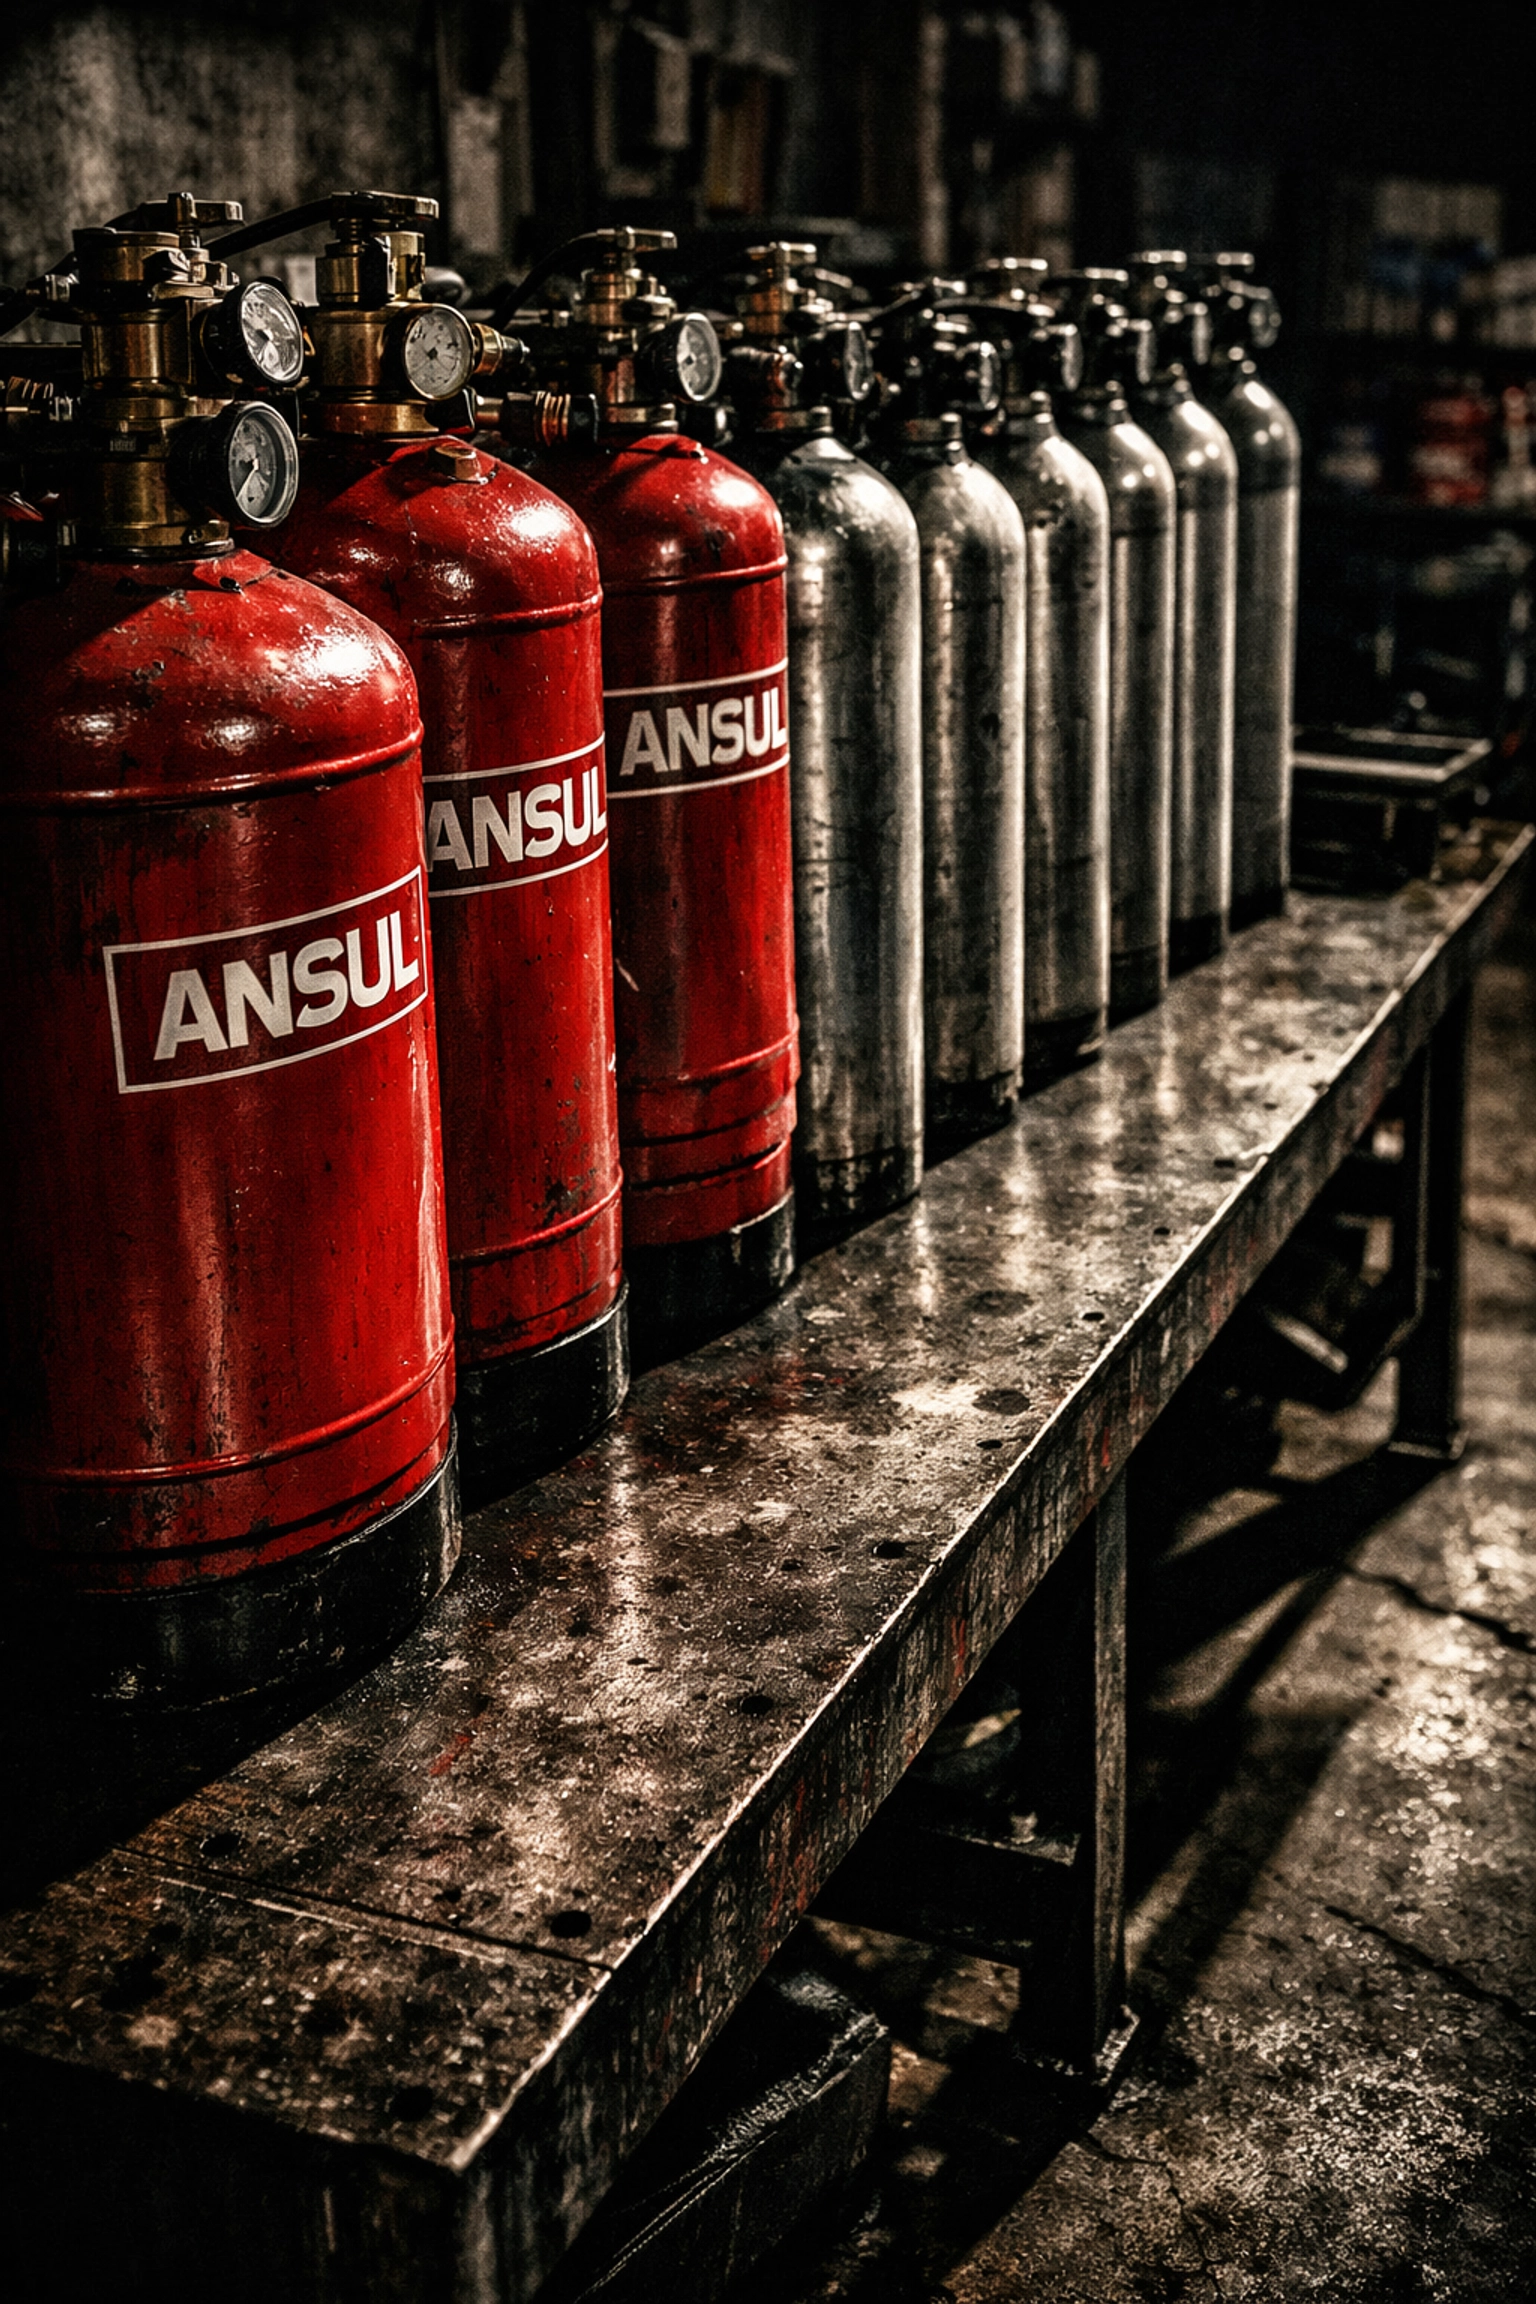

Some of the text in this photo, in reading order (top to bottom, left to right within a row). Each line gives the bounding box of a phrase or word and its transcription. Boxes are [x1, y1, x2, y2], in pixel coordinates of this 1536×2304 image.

[619, 687, 788, 777] ANSUL
[425, 766, 607, 872] ANSUL
[153, 910, 420, 1061] ANSUL
